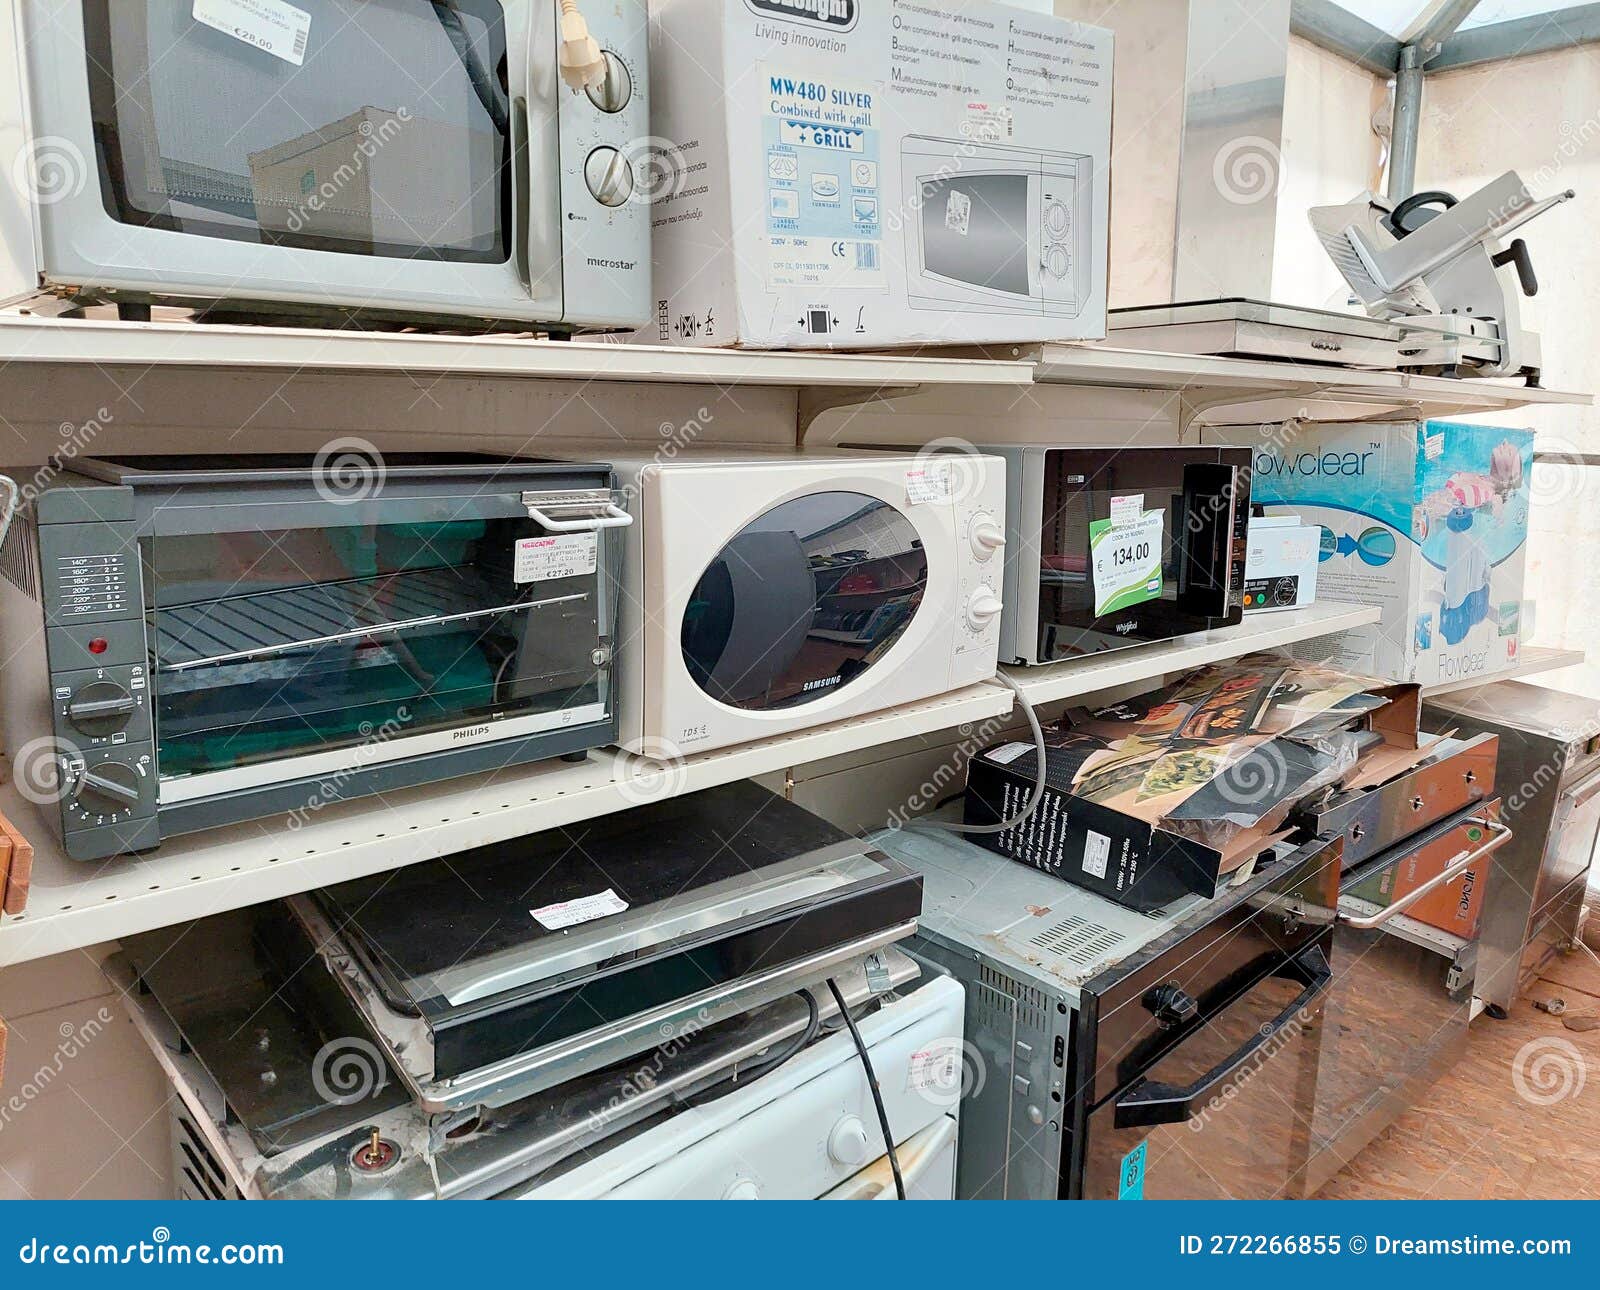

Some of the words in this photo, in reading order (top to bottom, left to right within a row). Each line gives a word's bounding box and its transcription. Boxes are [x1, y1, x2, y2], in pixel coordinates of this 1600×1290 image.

[755, 23, 789, 46] Living
[791, 30, 847, 53] innovation
[770, 76, 826, 103] MW480
[832, 89, 872, 109] SILVER
[825, 107, 846, 123] with
[850, 112, 872, 127] grill
[813, 132, 852, 149] GRILL
[1097, 560, 1103, 573] €
[1112, 542, 1150, 567] 134,00
[803, 674, 842, 691] SAMSUNG
[453, 726, 490, 740] PHILIPS
[1042, 791, 1051, 822] teppanyaki
[1048, 820, 1056, 850] teppanyaki
[1060, 811, 1068, 842] teppanyaki
